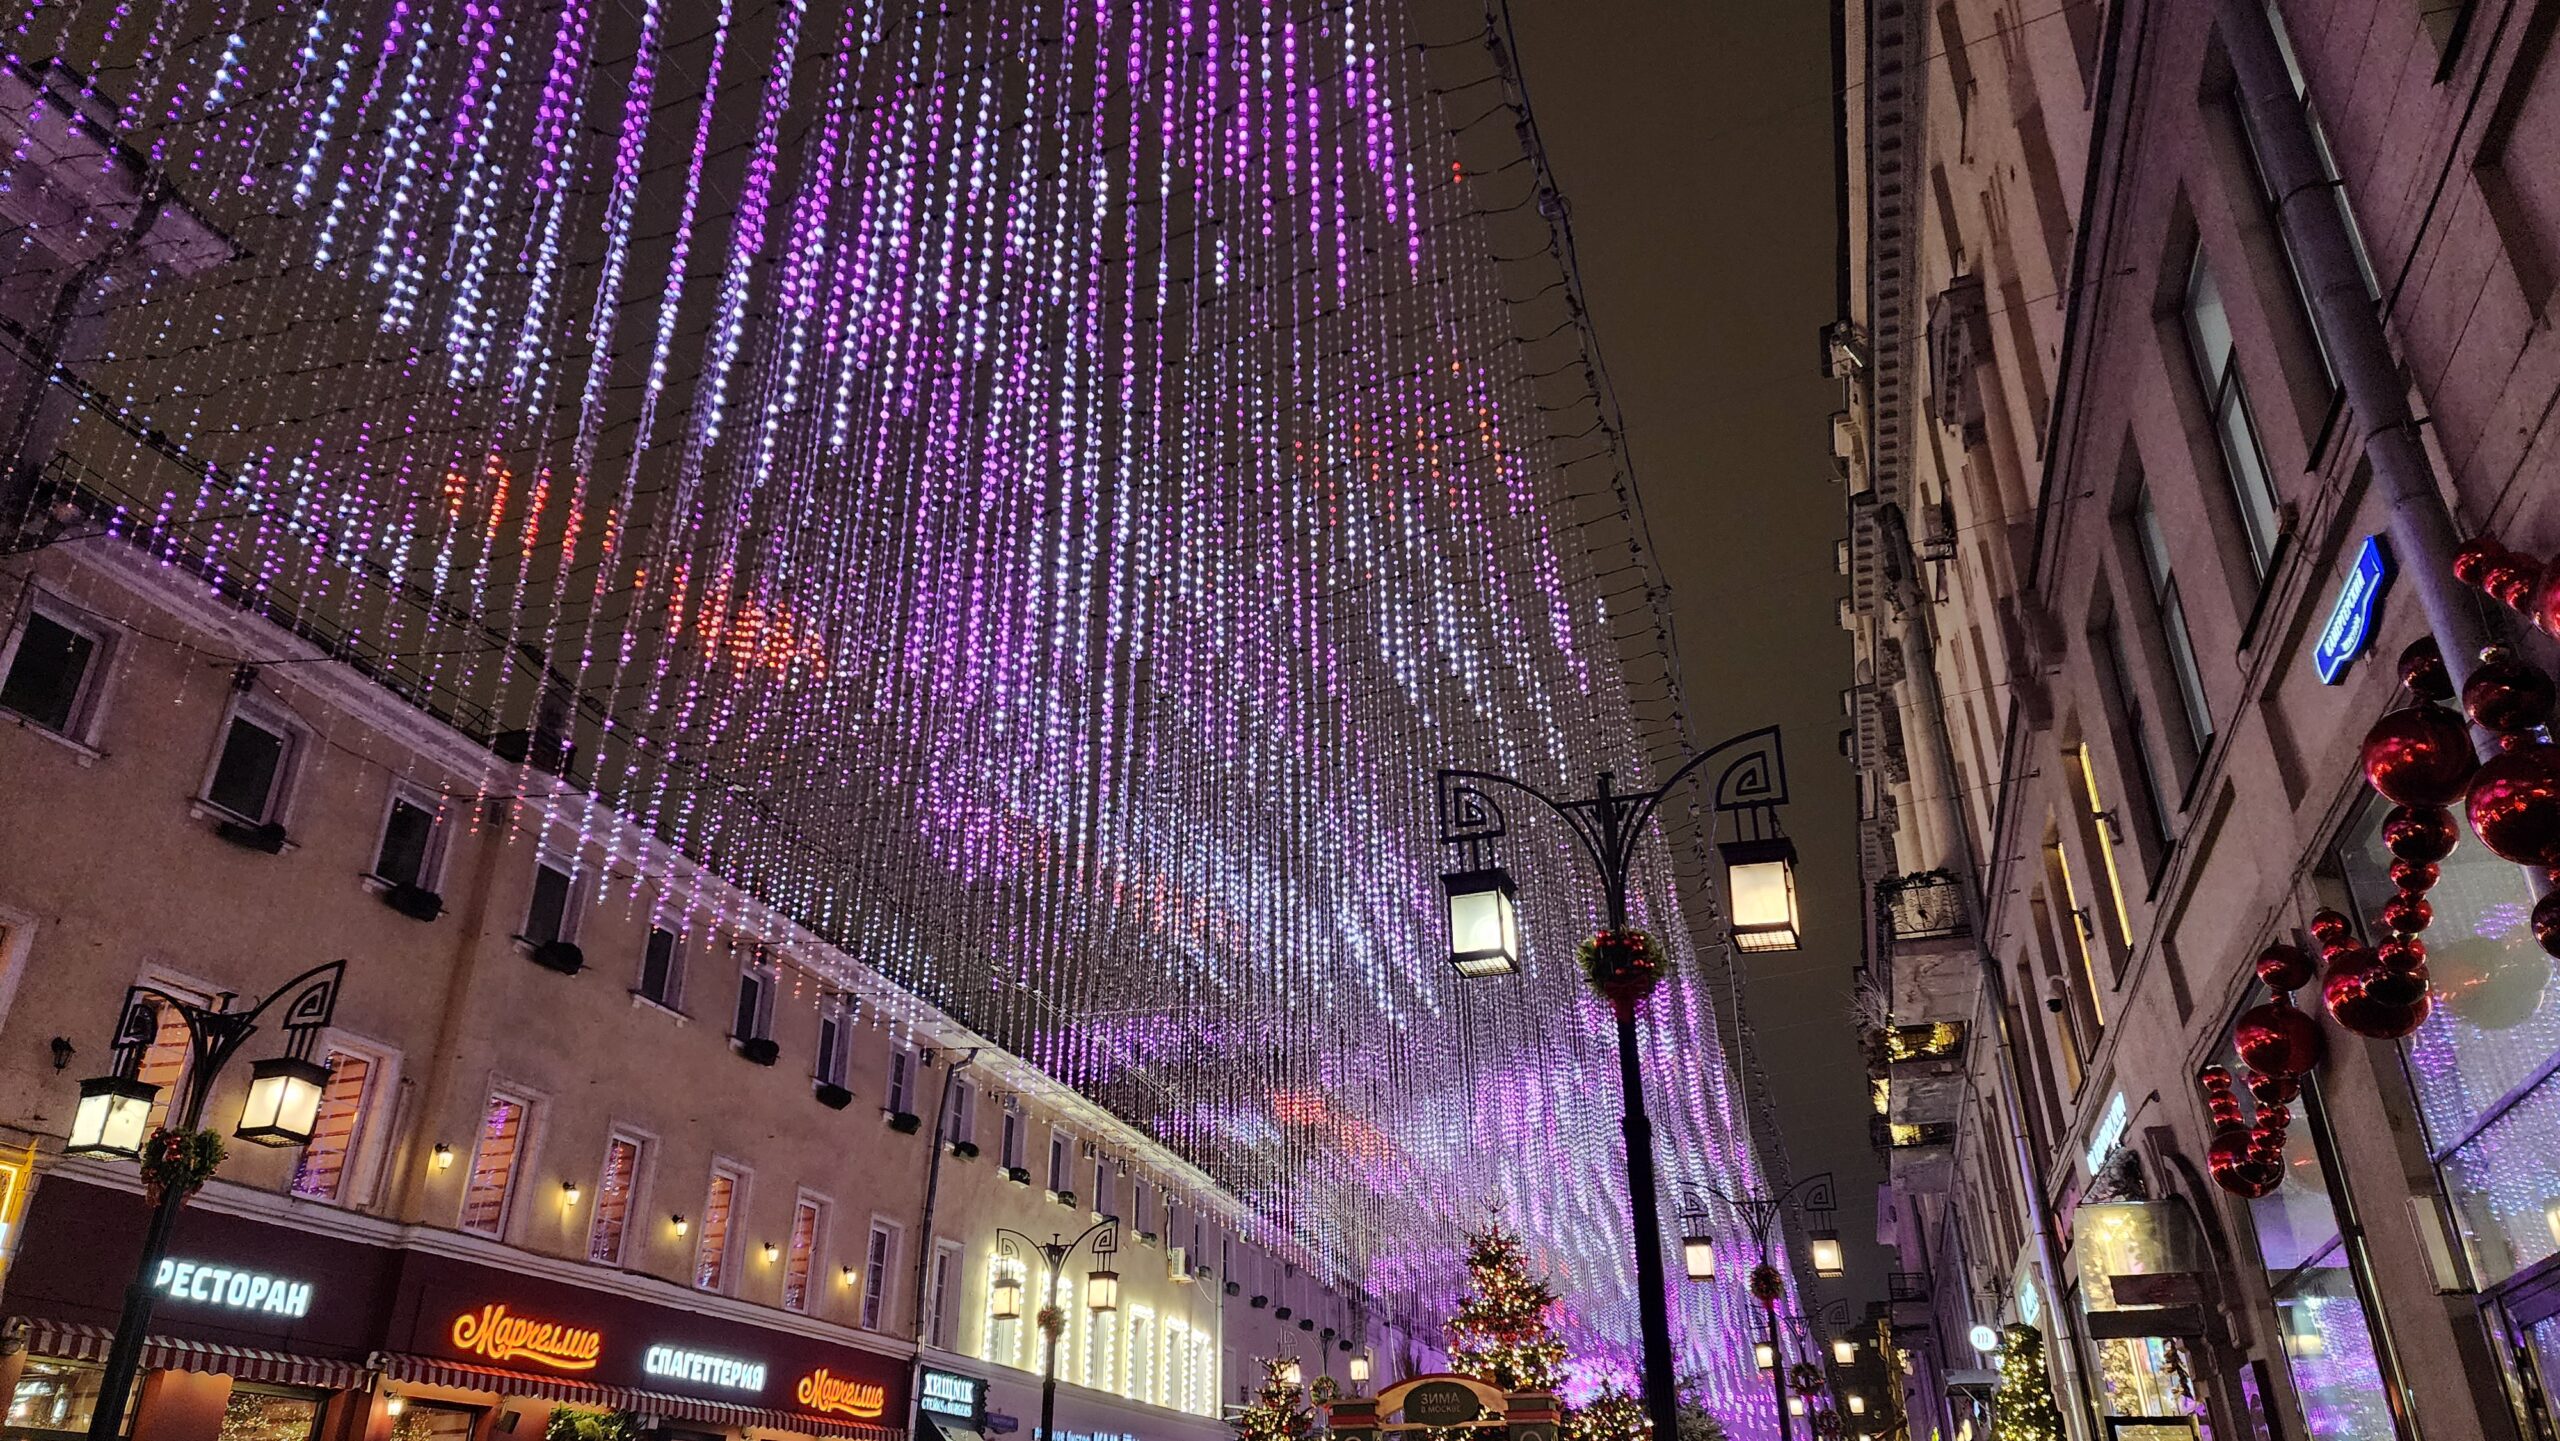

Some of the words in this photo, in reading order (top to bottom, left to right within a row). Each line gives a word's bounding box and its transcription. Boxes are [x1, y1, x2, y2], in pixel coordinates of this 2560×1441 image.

[155, 1259, 311, 1317] РЕСТОРАН
[646, 1346, 765, 1391] СПАГЕТТЕРИЯ
[1420, 1392, 1460, 1405] ЗИМА
